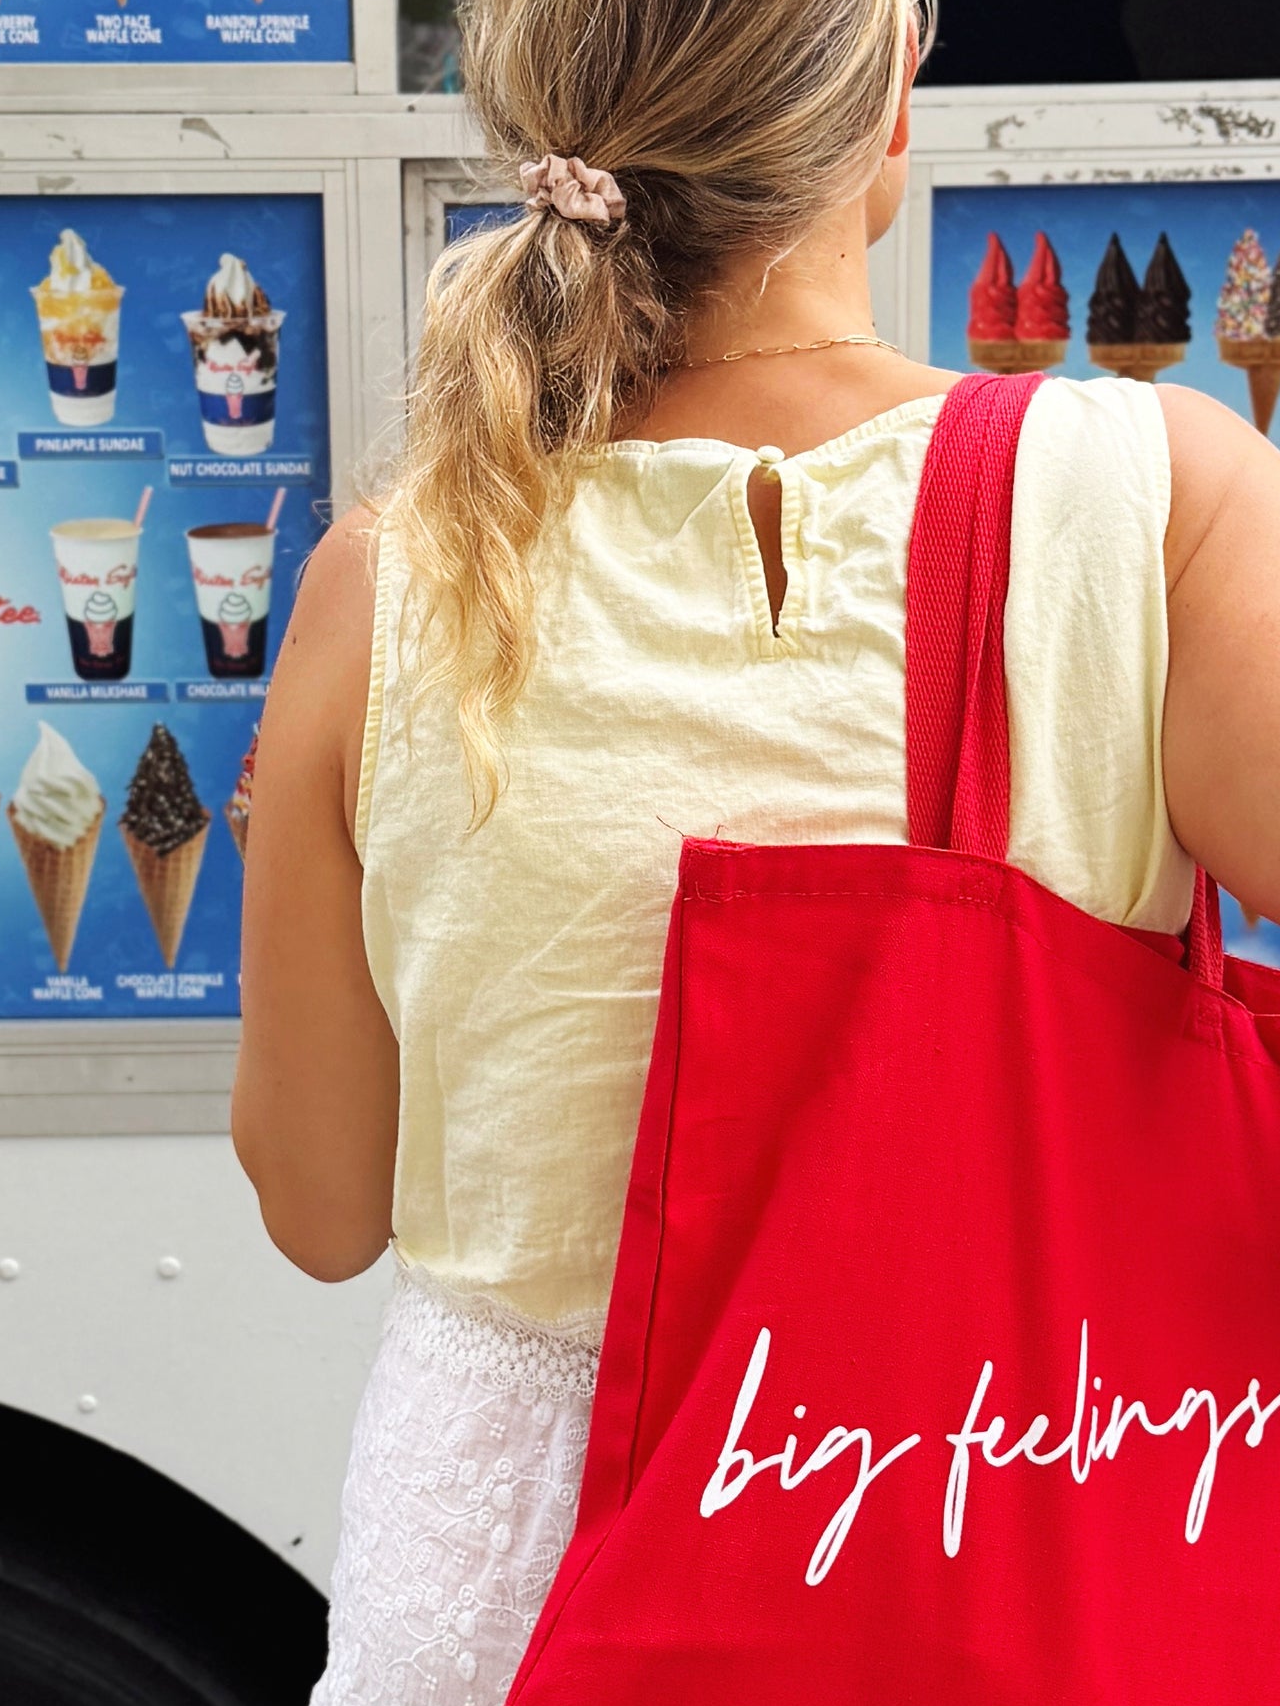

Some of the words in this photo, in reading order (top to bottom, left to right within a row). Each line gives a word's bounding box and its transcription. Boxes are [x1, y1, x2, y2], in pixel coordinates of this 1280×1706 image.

[96, 15, 121, 29] TWO
[123, 15, 151, 29] FACE
[206, 14, 256, 29] RAINBOW
[258, 14, 309, 29] SPRINKLE
[9, 29, 40, 44] CONE
[86, 29, 130, 43] WAFFLE
[132, 29, 162, 43] CONE
[221, 28, 264, 43] WAFFLE
[266, 28, 296, 43] CONE
[35, 438, 95, 451] PINEAPPLE
[98, 437, 145, 451] SUNDAE
[170, 463, 194, 476] NUT
[197, 463, 262, 476] CHOCOLATE
[265, 463, 311, 476] SUNDAE
[47, 685, 88, 698] VANILLA
[90, 685, 148, 698] MILKSHAKE
[187, 684, 246, 697] CHOCOLATE
[46, 976, 89, 988] VANILLA
[116, 974, 175, 987] CHOCOLATE
[177, 974, 224, 986] SPRINKLE
[33, 987, 73, 1000] WAFFLE
[75, 987, 103, 1000] CONE
[135, 985, 175, 999] WAFFLE
[177, 985, 206, 999] CONE
[699, 1326, 921, 1587] big
